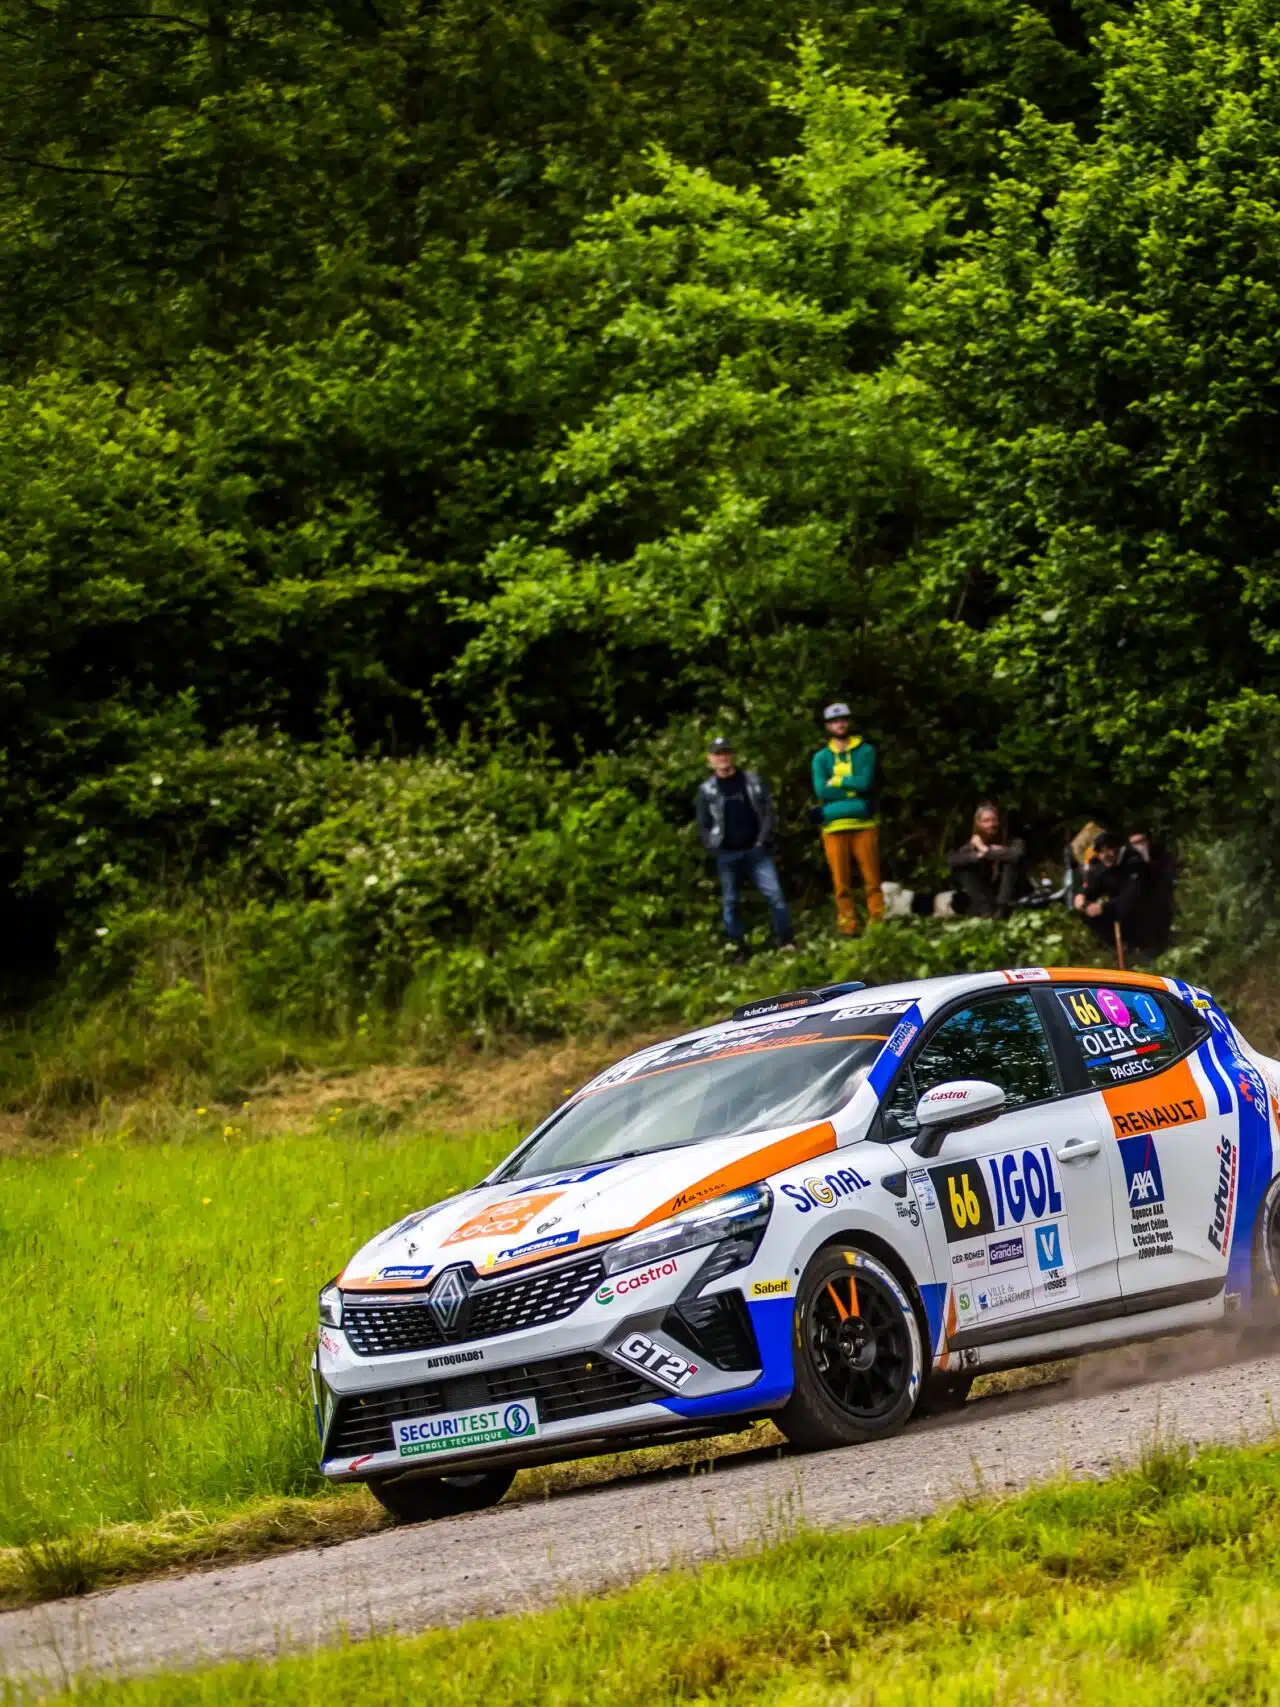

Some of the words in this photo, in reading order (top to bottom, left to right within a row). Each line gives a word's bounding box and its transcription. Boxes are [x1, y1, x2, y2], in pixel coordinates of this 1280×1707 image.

[1069, 993, 1101, 1026] 66
[1103, 996, 1120, 1019] F
[1145, 1000, 1156, 1024] J
[1082, 1028, 1131, 1055] OLEA
[1130, 1024, 1151, 1042] C.
[1109, 1060, 1142, 1080] PAGES
[1141, 1058, 1154, 1071] C.
[931, 1091, 967, 1101] Castrol
[1114, 1100, 1199, 1133] RENAULT
[989, 1147, 1062, 1226] IGOL
[1129, 1170, 1158, 1202] AXA
[1207, 1134, 1232, 1252] Futuris
[947, 1173, 981, 1229] 66
[1132, 1208, 1152, 1220] Agence
[1153, 1203, 1164, 1215] AXA
[1131, 1221, 1151, 1234] Imbert
[1155, 1231, 1173, 1242] Pages
[512, 1236, 568, 1256] MICHELIN
[615, 1258, 679, 1295] Castrol
[1044, 1277, 1067, 1291] VOSGES
[1048, 1269, 1060, 1279] VIE
[754, 1280, 788, 1295] Sabelt
[987, 1284, 1005, 1297] VILLE
[427, 1350, 484, 1369] AUTOQUAD81
[618, 1331, 699, 1386] GT2i
[400, 1411, 500, 1442] SECURITEST
[401, 1440, 448, 1454] CONTROLE
[449, 1431, 503, 1446] TECHNIQUE
